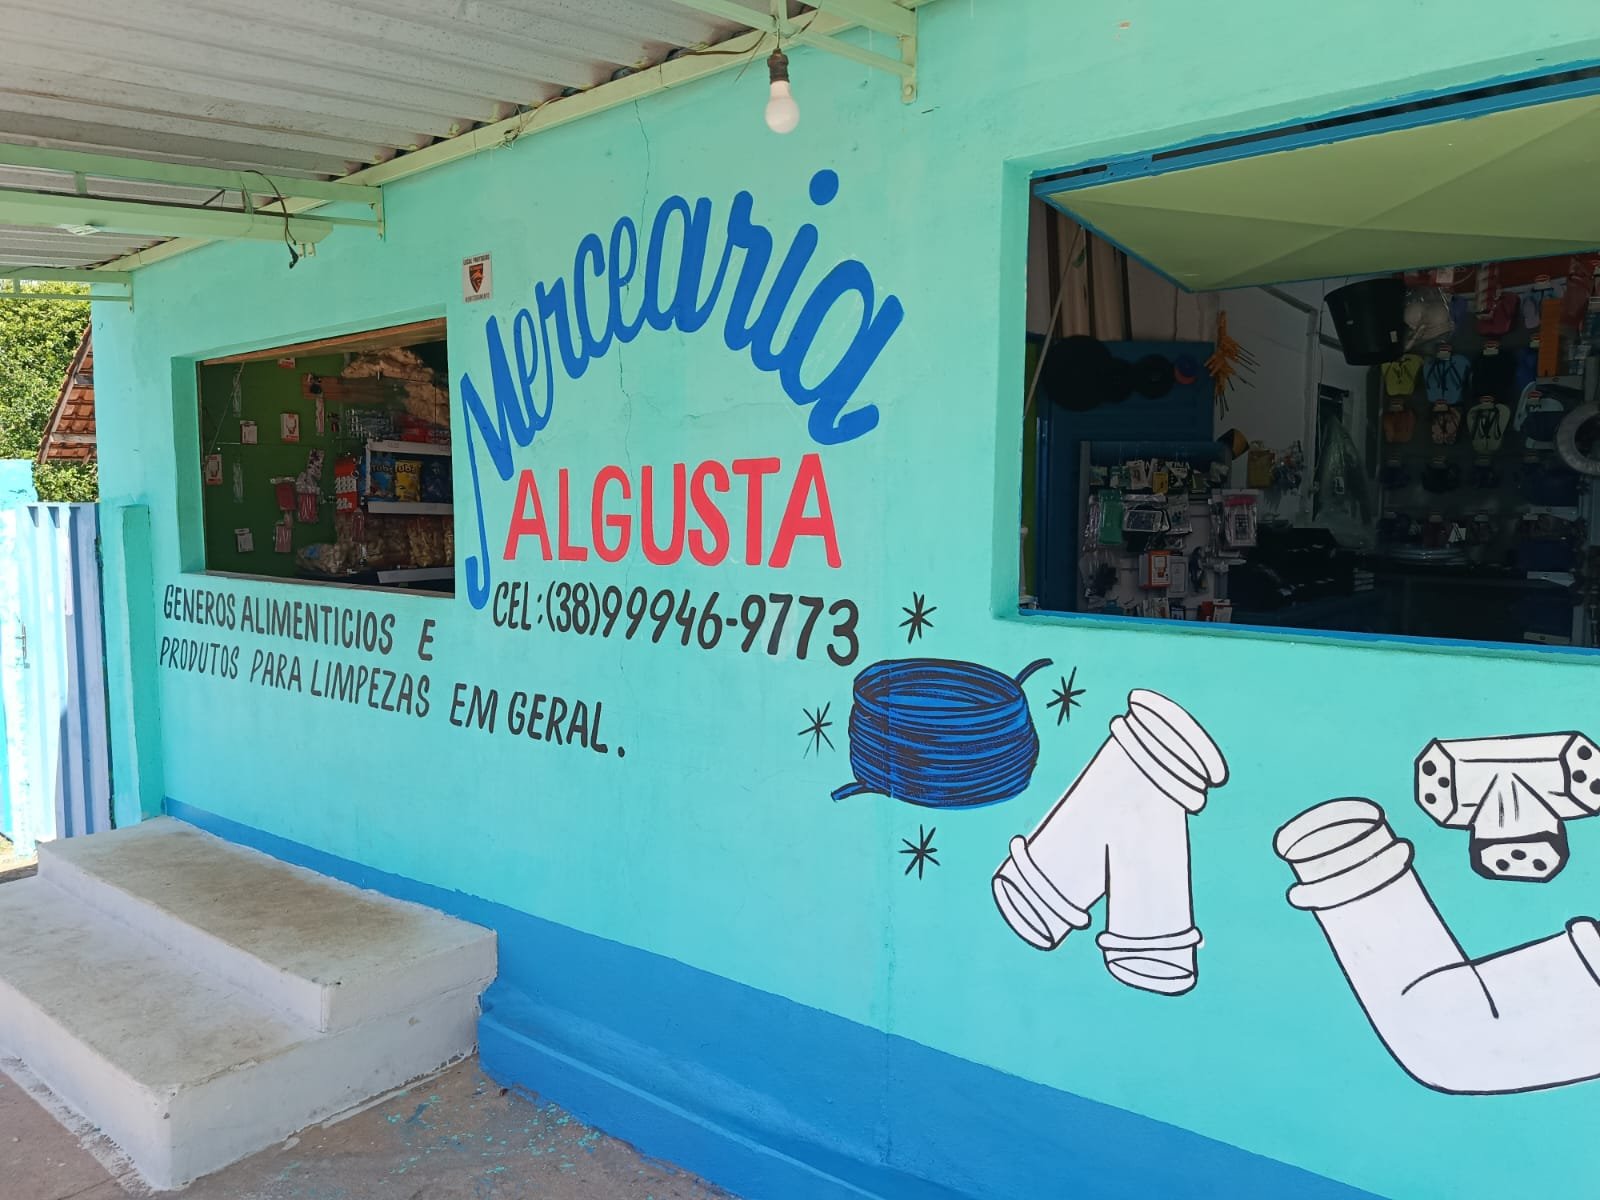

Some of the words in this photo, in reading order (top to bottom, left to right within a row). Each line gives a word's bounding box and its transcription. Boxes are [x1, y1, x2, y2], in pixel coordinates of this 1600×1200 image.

[460, 169, 904, 610] Mercearia
[503, 454, 842, 568] ALGUSTA
[163, 584, 236, 631] GENEROS
[240, 595, 396, 655] ALIMENTICIOS
[417, 618, 436, 662] E
[159, 636, 240, 680] PRODUTOS
[249, 649, 303, 693] PARA
[310, 659, 430, 718] LIMPEZAS
[449, 682, 499, 734] EM
[507, 691, 626, 758] GERAL.
